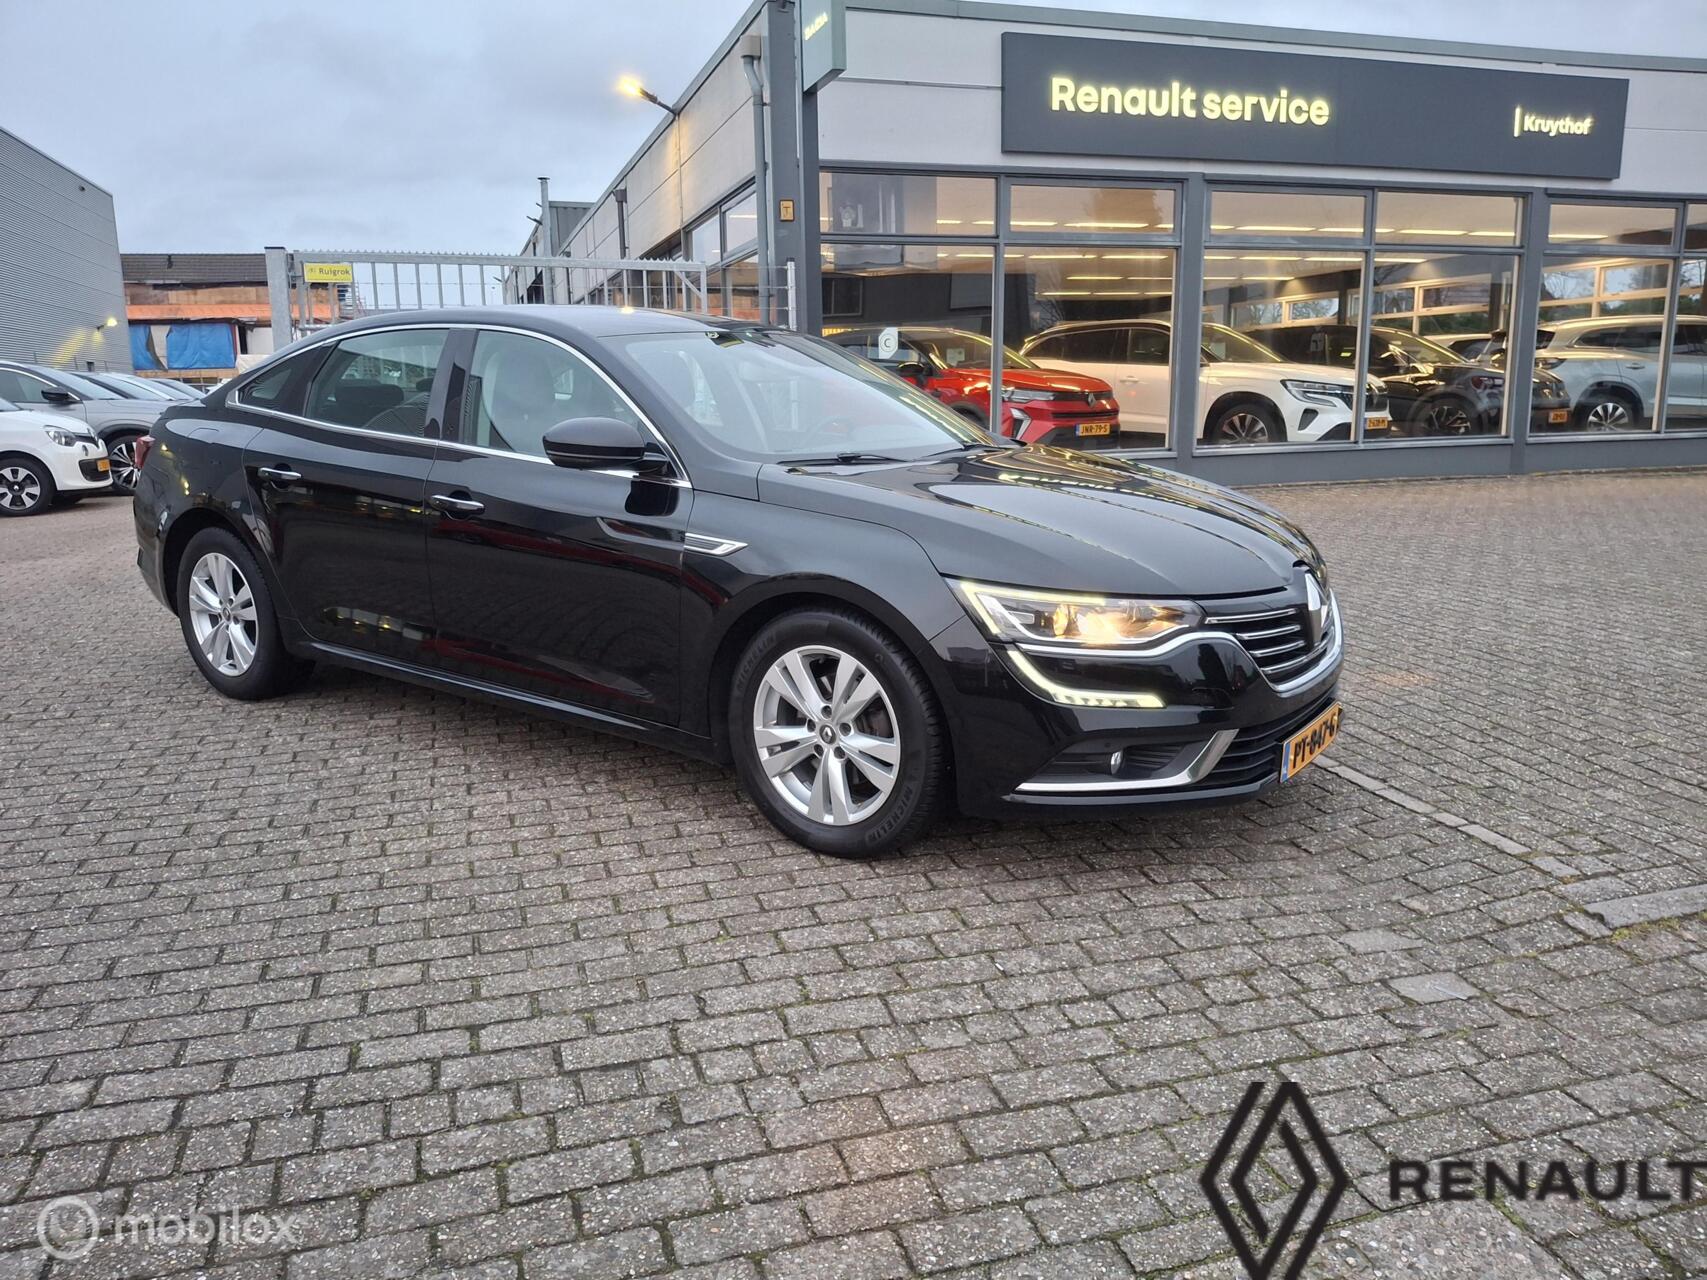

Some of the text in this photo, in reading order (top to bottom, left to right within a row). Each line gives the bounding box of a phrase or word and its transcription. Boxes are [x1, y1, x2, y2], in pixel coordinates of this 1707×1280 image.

[1051, 77, 1330, 125] Renault service
[1524, 115, 1593, 137] Kruythof
[318, 267, 351, 276] Ruigrok
